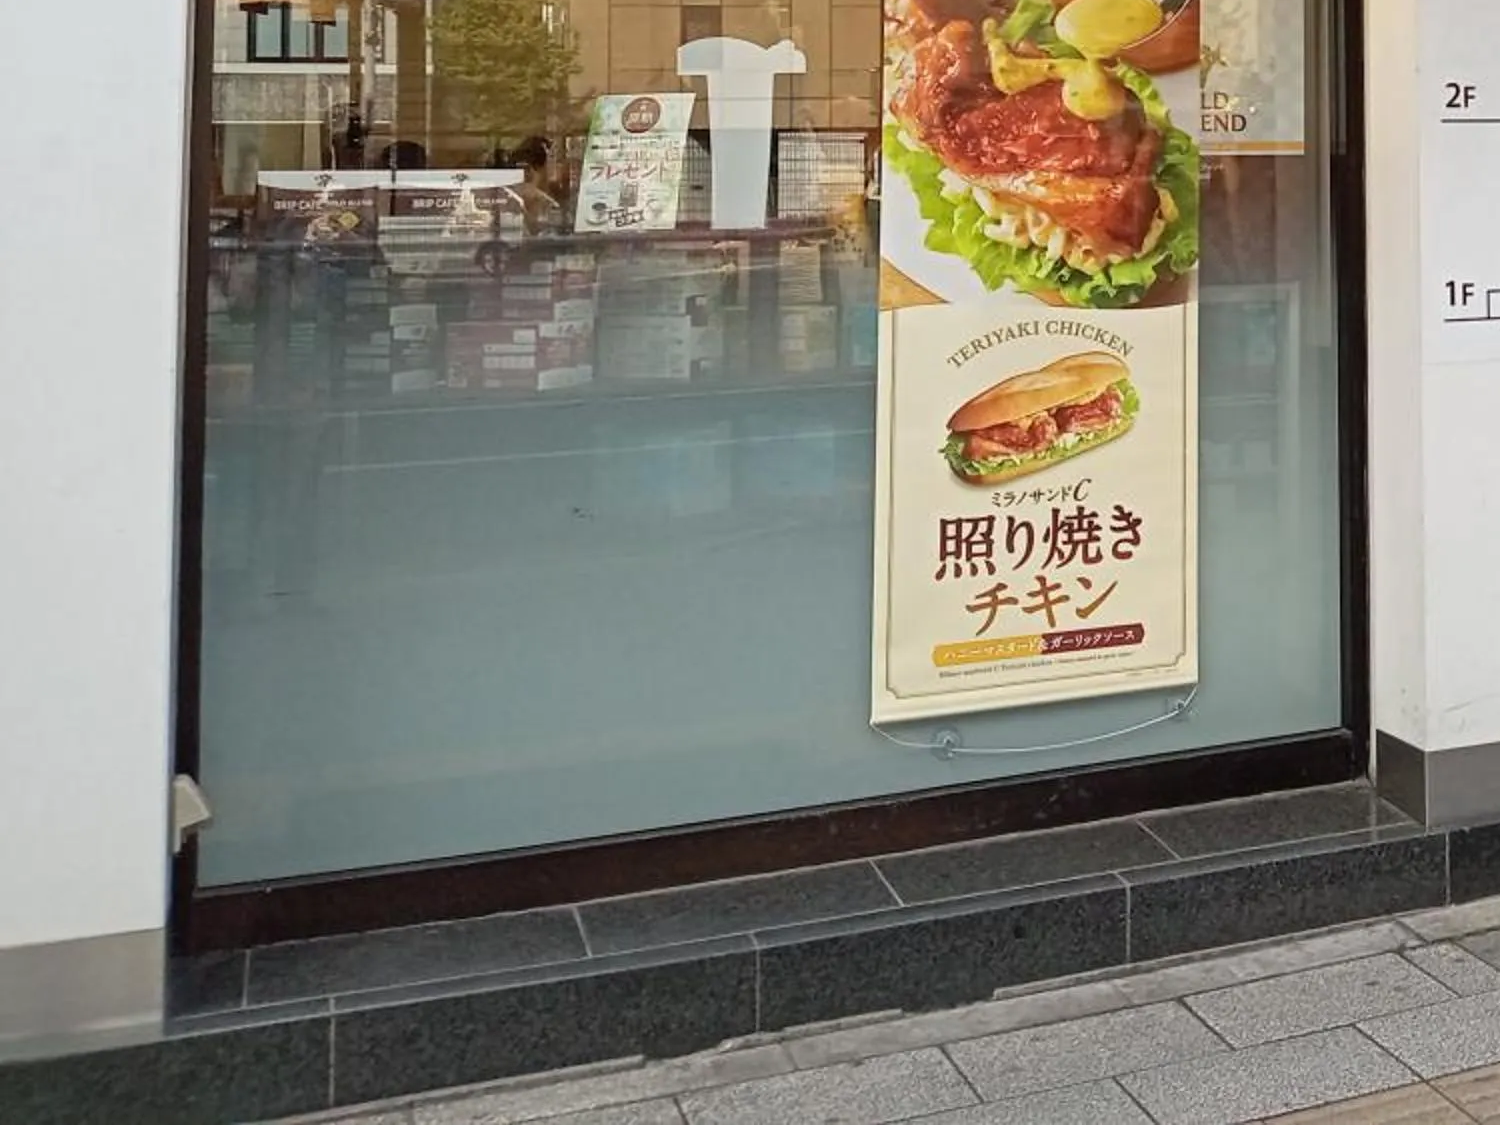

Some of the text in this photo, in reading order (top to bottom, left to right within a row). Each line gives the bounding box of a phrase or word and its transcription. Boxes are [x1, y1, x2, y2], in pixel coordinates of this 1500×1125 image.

[1200, 91, 1230, 111] LD
[1445, 83, 1476, 109] 2F
[1200, 114, 1248, 132] END
[1445, 281, 1475, 307] 1F
[947, 320, 1134, 368] TERIYAKI CHICKEN
[935, 505, 1143, 581] 照り焼き
[966, 575, 1119, 637] チキン
